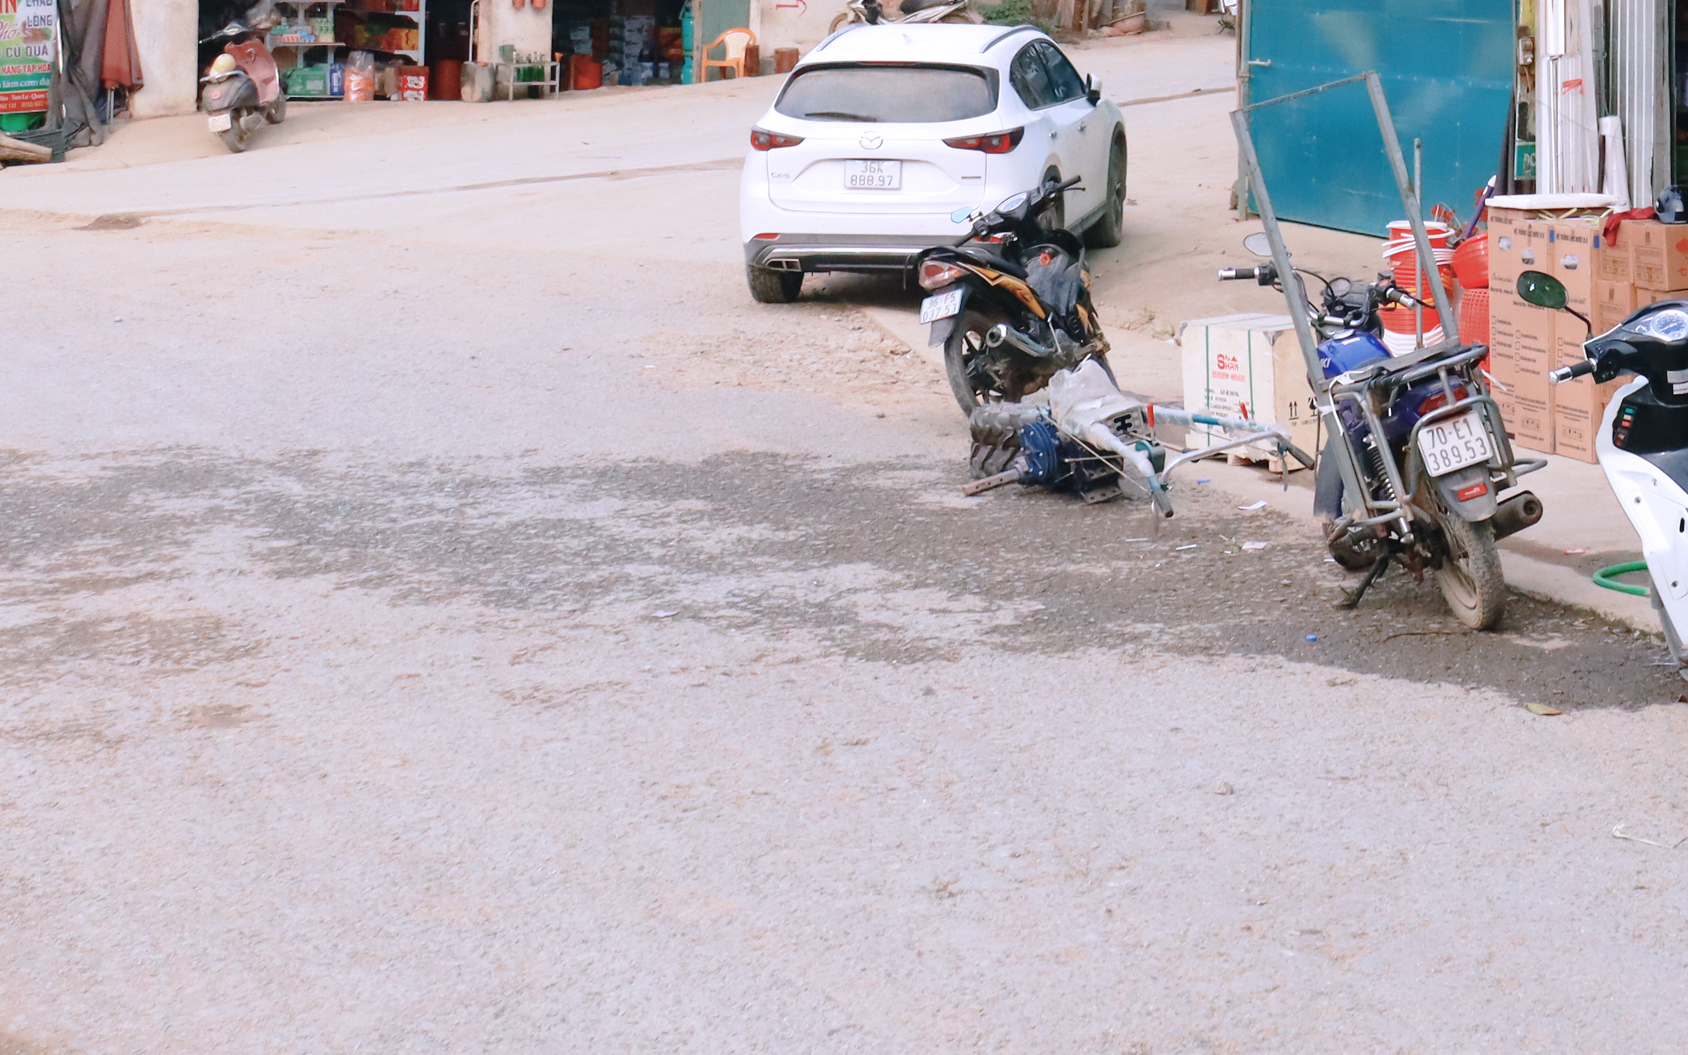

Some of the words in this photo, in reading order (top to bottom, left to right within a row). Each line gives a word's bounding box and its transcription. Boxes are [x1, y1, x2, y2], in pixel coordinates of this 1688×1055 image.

[850, 174, 894, 186] 888.97
[1426, 417, 1473, 449] 70-E1
[1428, 437, 1488, 471] 389.53
